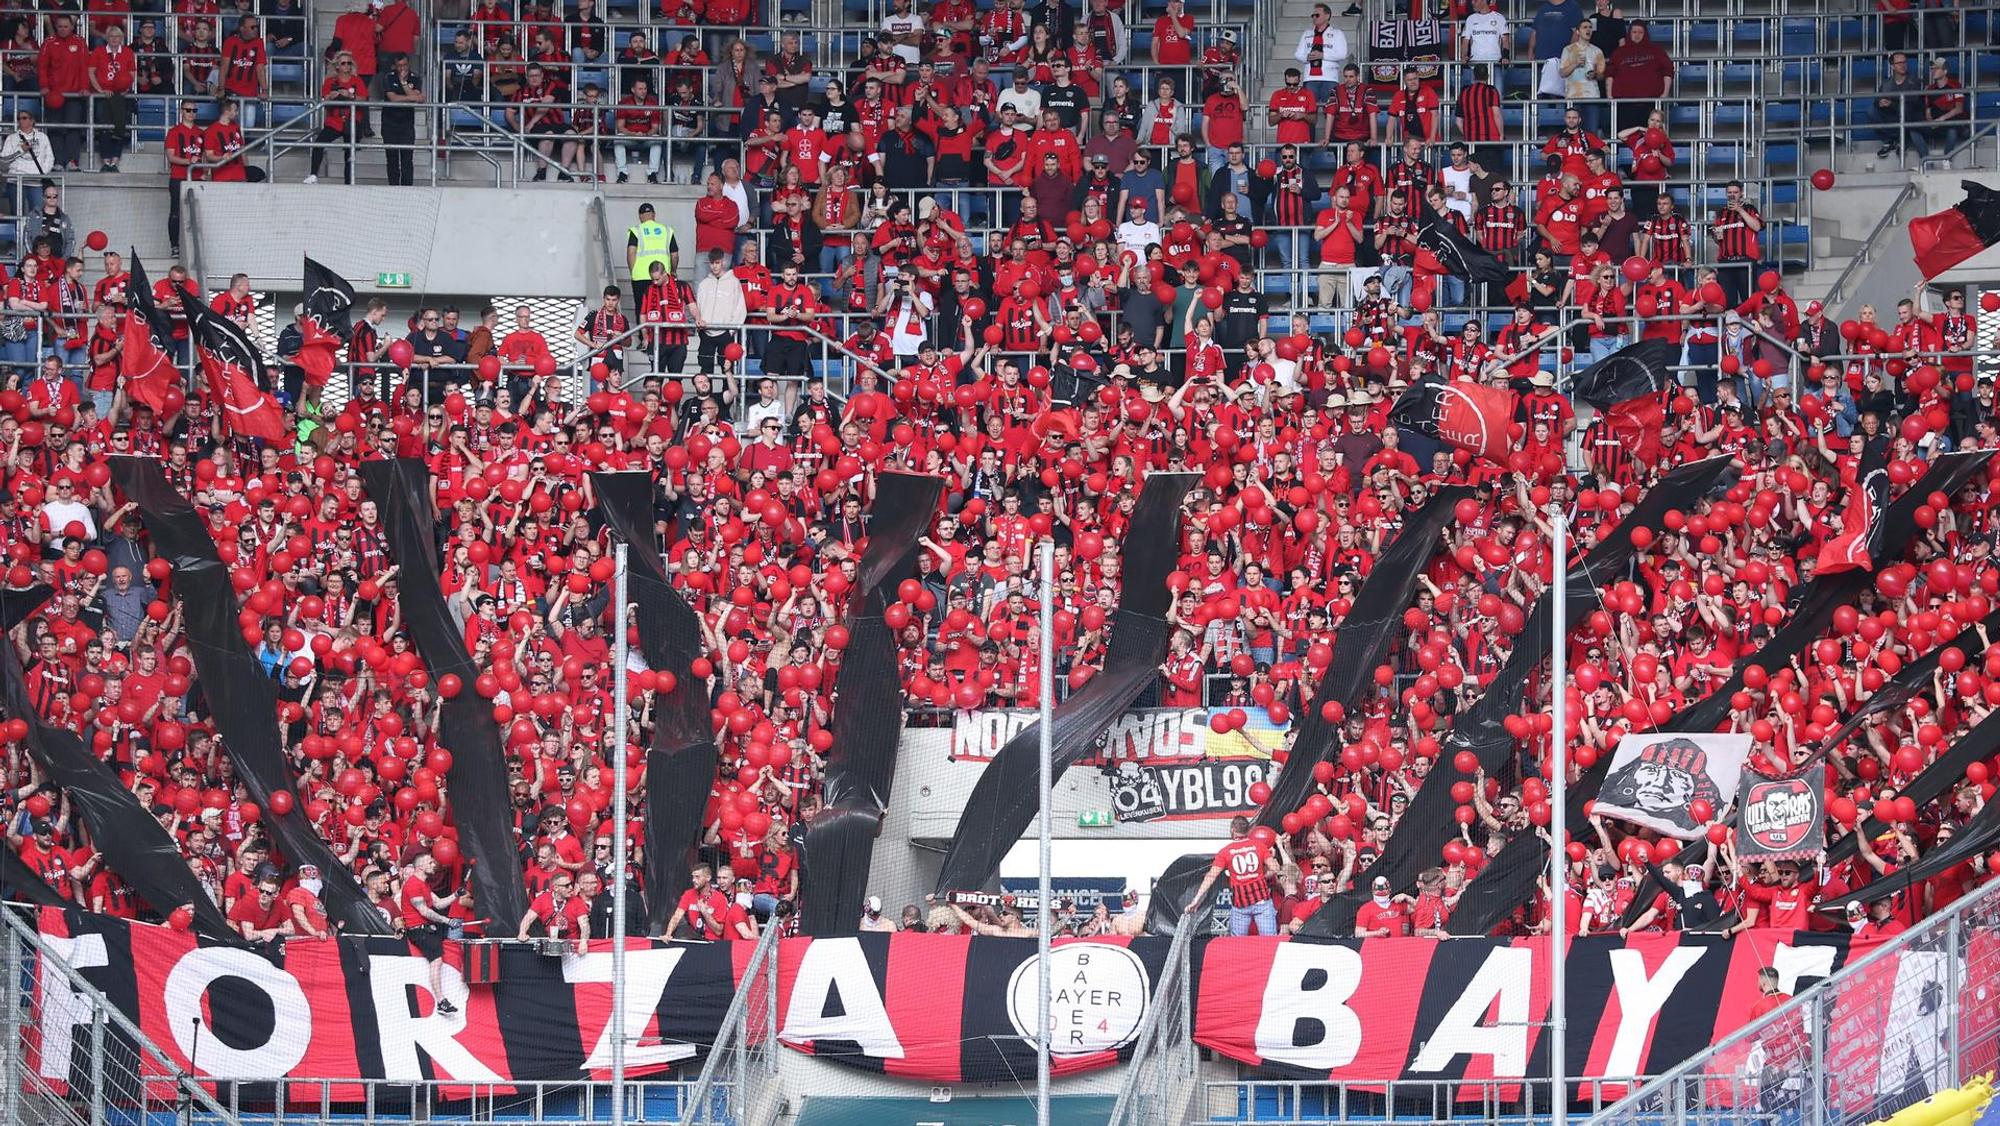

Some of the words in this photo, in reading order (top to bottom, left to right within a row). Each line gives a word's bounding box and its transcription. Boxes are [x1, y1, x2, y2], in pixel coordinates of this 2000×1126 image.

[1379, 21, 1396, 48] BAY
[1565, 213, 1577, 222] LG
[1179, 244, 1191, 253] LG
[1161, 765, 1263, 810] YBL98
[1232, 852, 1259, 875] 09
[40, 930, 906, 1083] FORZA
